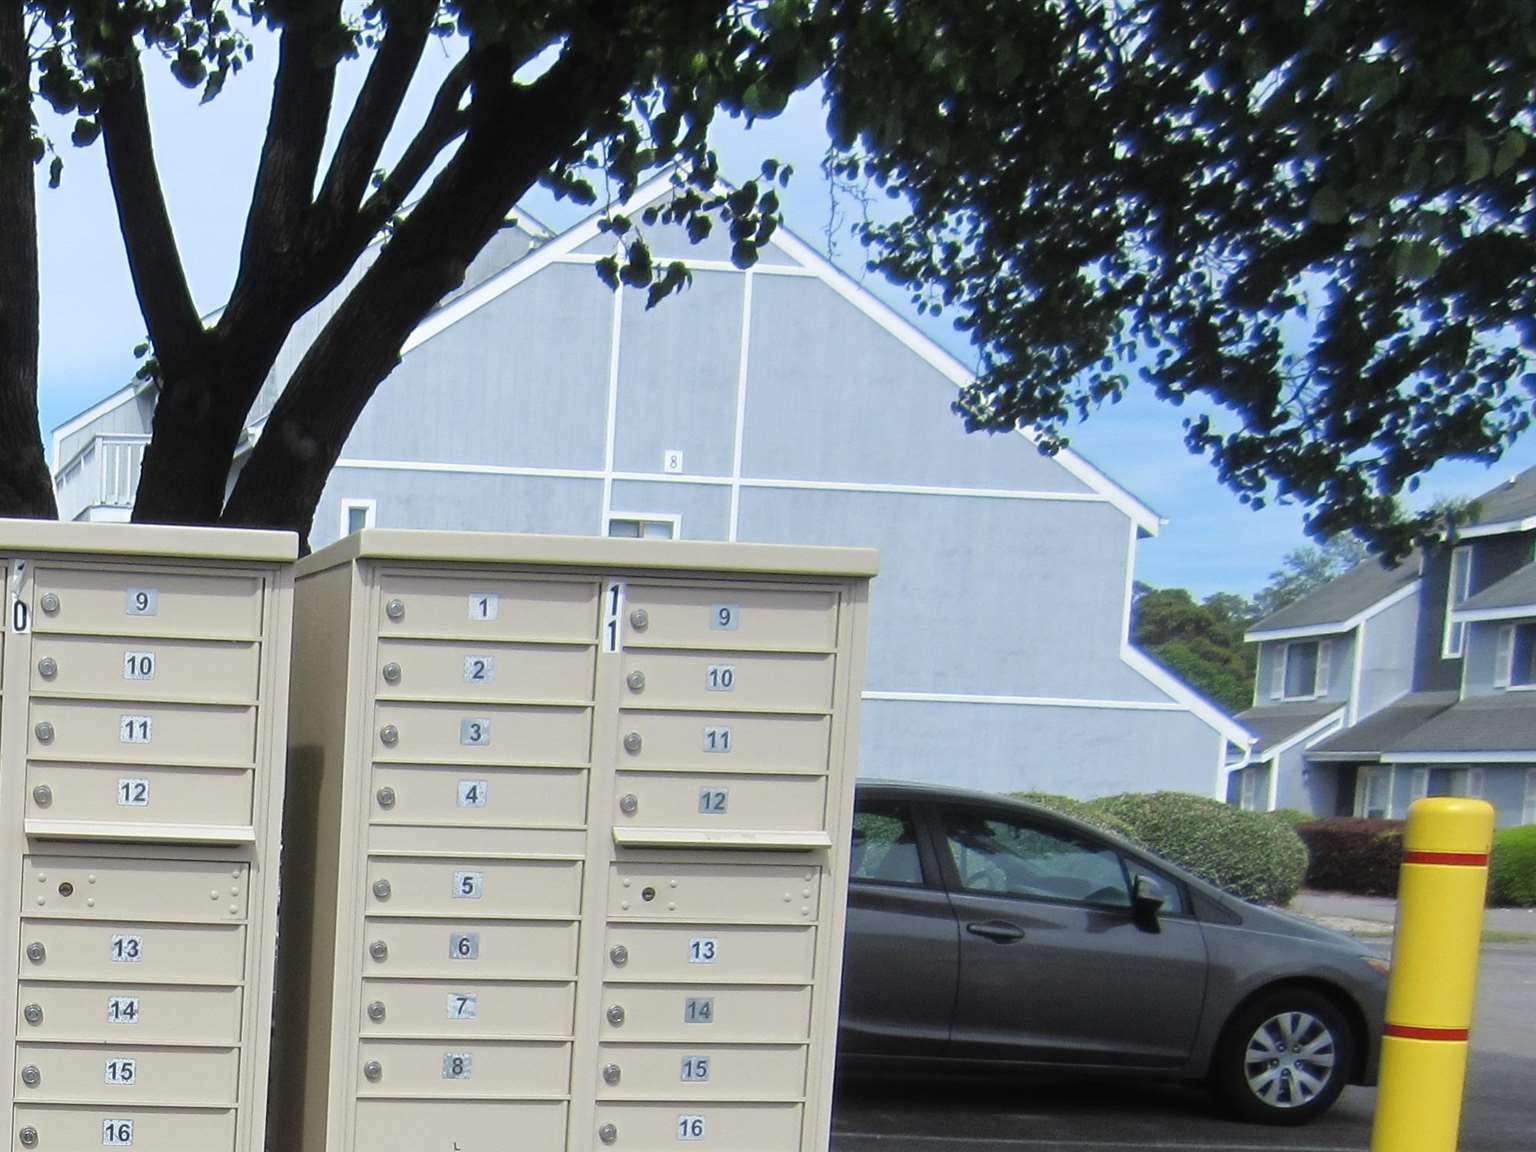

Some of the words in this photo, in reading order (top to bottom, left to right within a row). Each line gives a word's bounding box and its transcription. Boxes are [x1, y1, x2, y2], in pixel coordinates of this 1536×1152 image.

[669, 454, 679, 470] 8
[135, 590, 150, 613] 9
[478, 596, 489, 618] 1
[718, 606, 732, 628] 9
[127, 655, 152, 676] 10
[471, 659, 486, 681] 2
[709, 668, 733, 688] 10
[125, 719, 148, 740] 11
[468, 722, 483, 743] 3
[707, 730, 729, 749] 11
[121, 782, 146, 802] 12
[464, 783, 480, 805] 4
[701, 791, 726, 811] 12
[460, 875, 475, 896] 5
[113, 938, 139, 958] 13
[457, 936, 471, 957] 6
[691, 941, 715, 960] 13
[110, 1000, 137, 1020] 14
[455, 996, 470, 1016] 7
[687, 1000, 711, 1020] 14
[108, 1061, 133, 1081] 15
[450, 1056, 465, 1077] 8
[684, 1060, 707, 1078] 15
[105, 1123, 131, 1142] 16
[679, 1119, 703, 1137] 16
[453, 1141, 461, 1152] L
